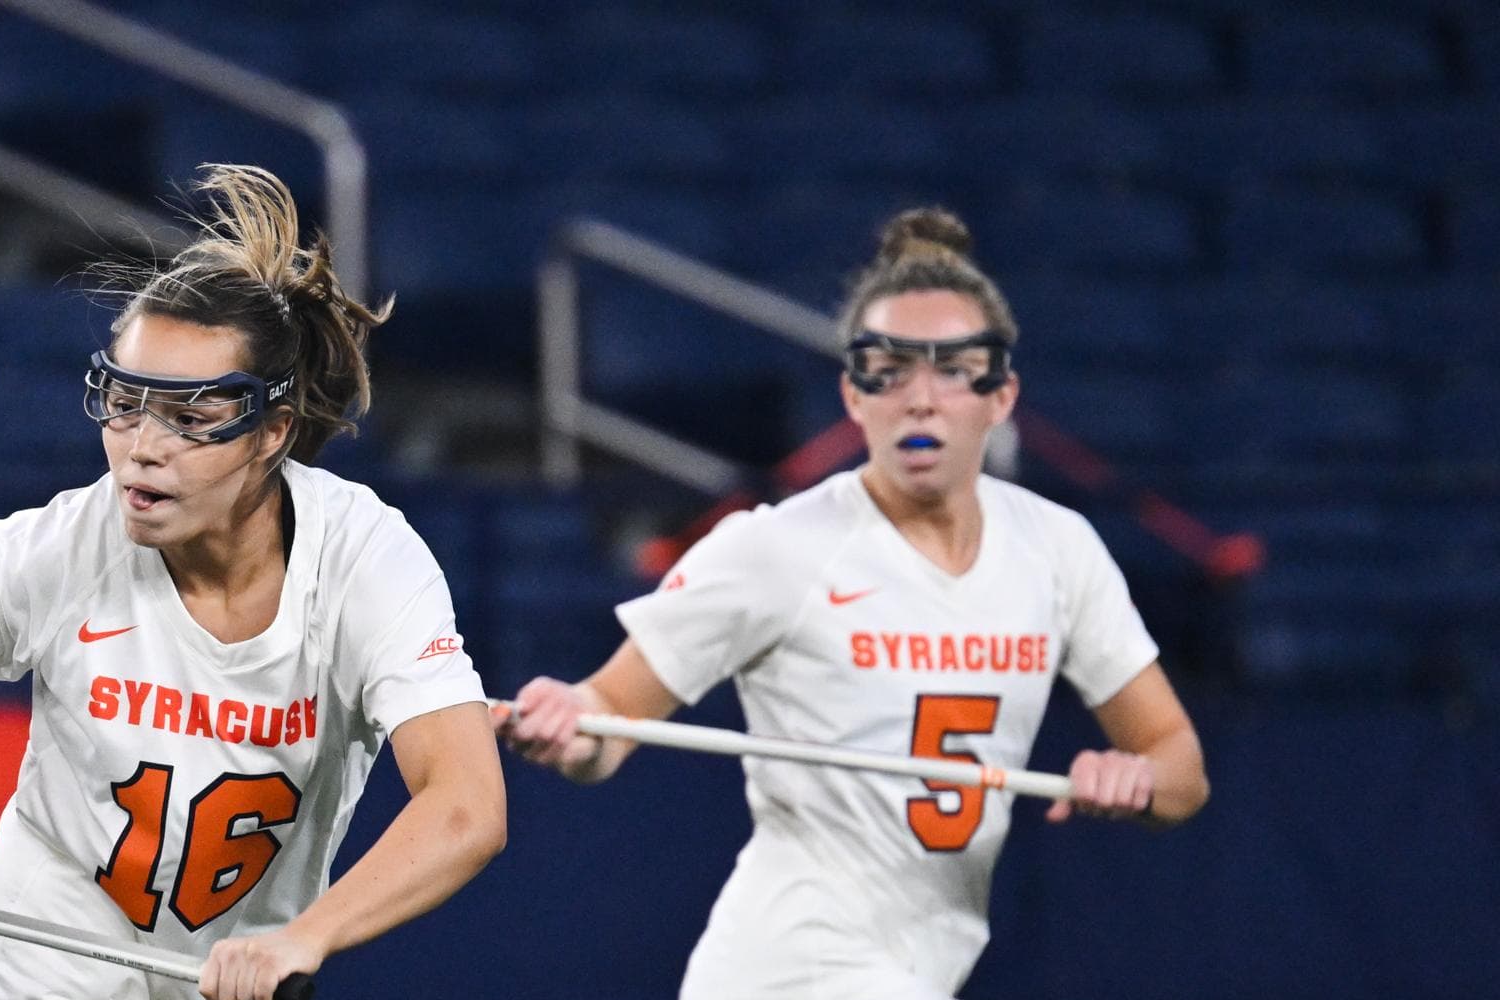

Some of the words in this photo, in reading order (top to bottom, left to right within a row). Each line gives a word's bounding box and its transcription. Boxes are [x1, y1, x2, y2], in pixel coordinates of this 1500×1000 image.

[419, 637, 460, 657] ACC
[851, 632, 1049, 673] SYRACUSE
[906, 694, 1002, 853] 5
[95, 761, 302, 932] 16
